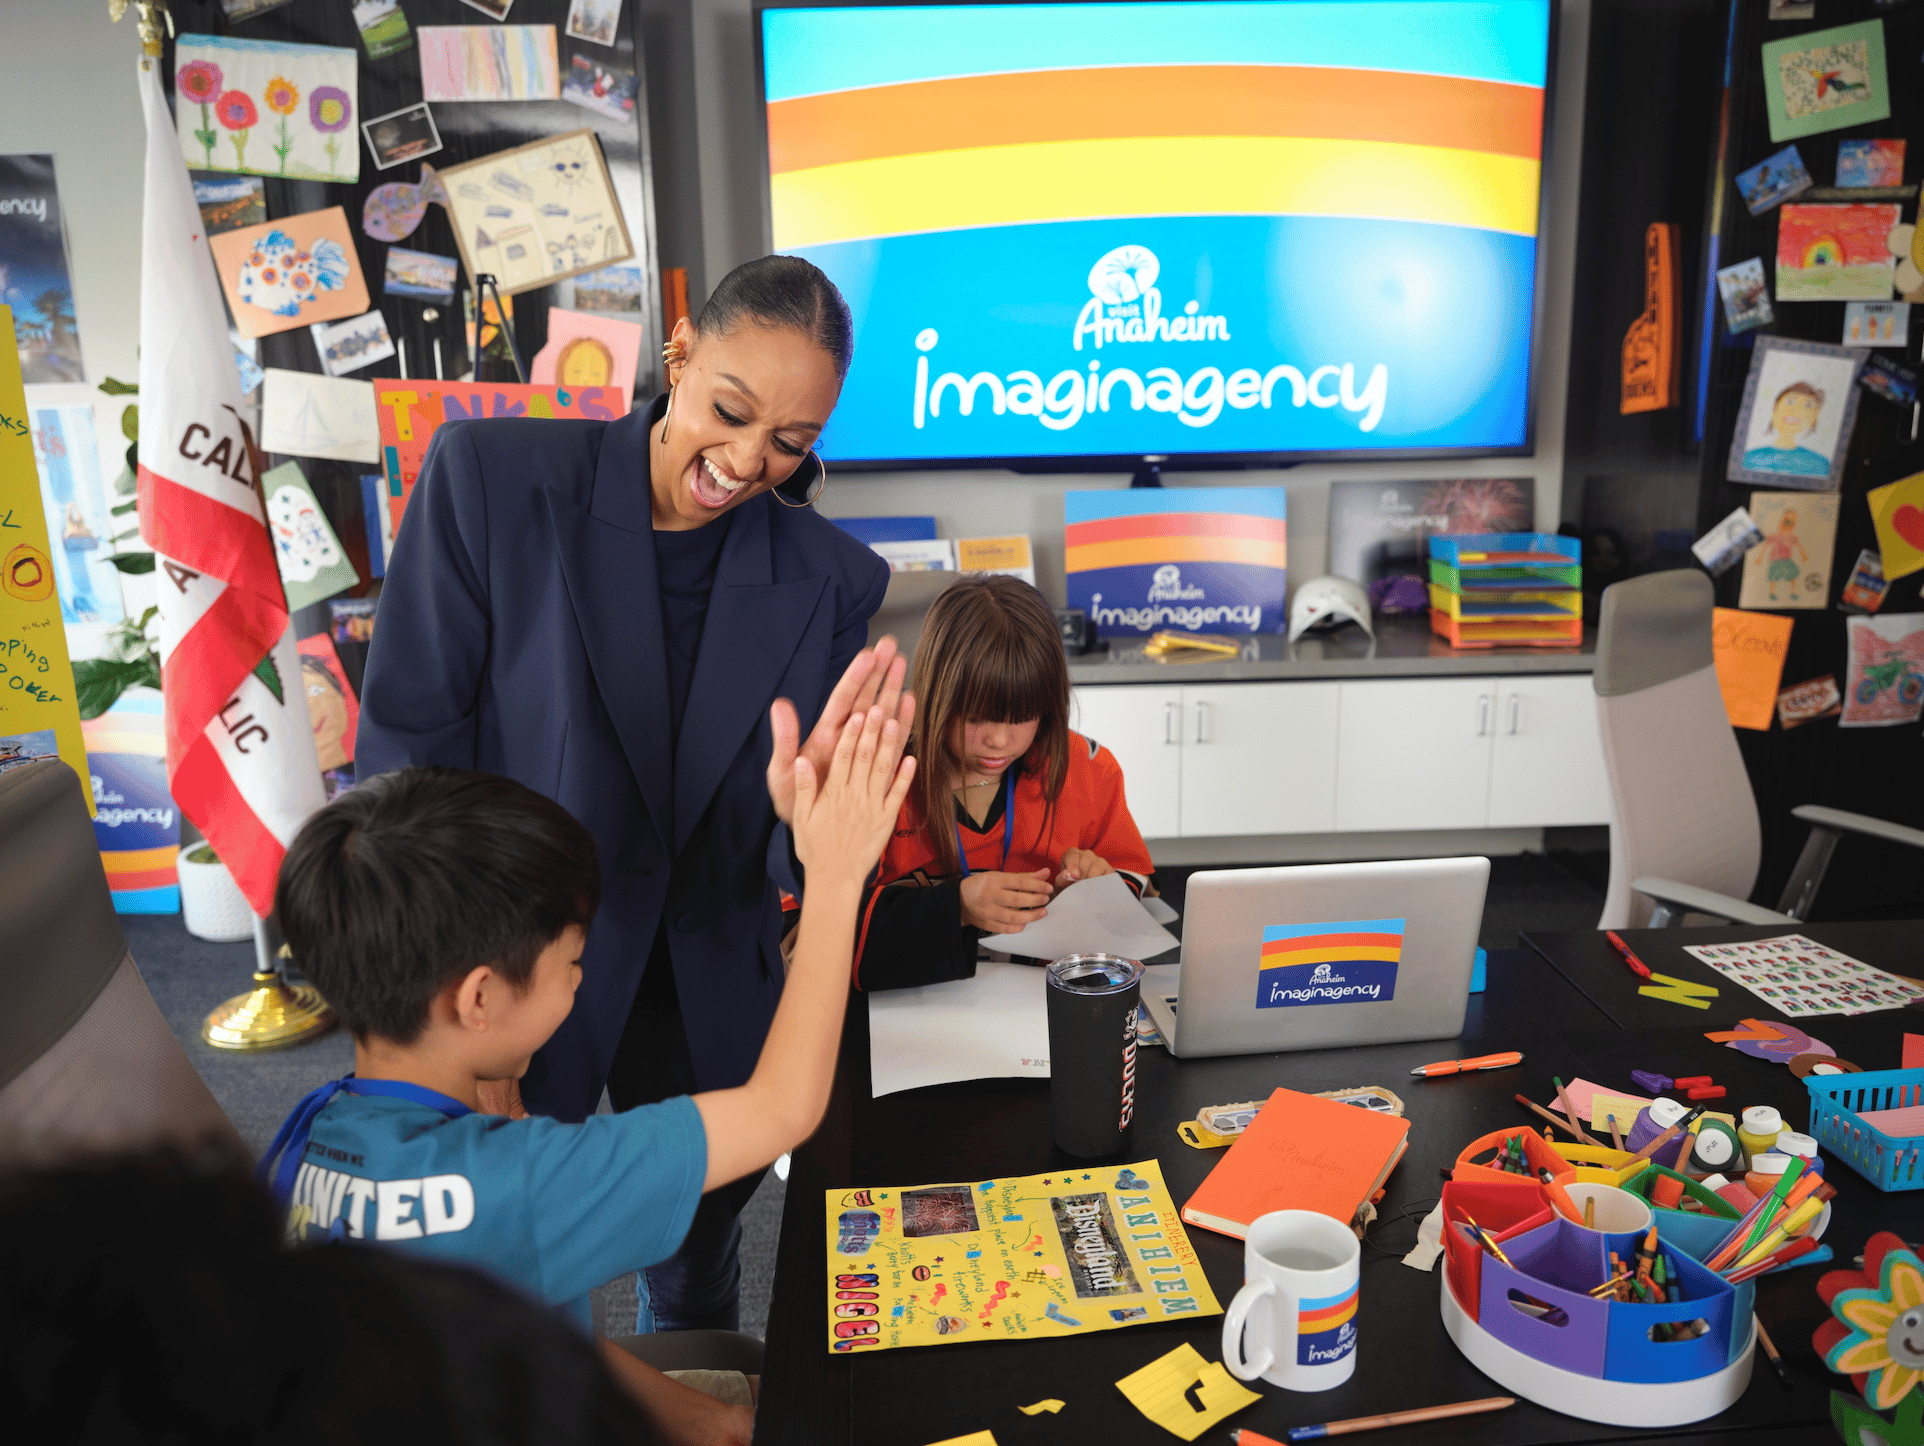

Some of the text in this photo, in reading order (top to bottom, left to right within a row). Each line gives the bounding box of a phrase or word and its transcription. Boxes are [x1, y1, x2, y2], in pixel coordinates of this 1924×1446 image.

[1073, 286, 1231, 351] Anaheim
[913, 327, 1389, 433] imaginagency
[179, 422, 256, 490] CAL
[1091, 592, 1262, 632] imaginagency
[1270, 981, 1381, 1003] imaginagency
[1309, 972, 1346, 986] Anaheim
[1121, 1040, 1138, 1130] DUCKS
[966, 1242, 987, 1295] Dineyland
[1066, 1198, 1127, 1291] Disneyland
[1118, 1193, 1202, 1317] ANIHIEM
[833, 1273, 881, 1353] NIGEL
